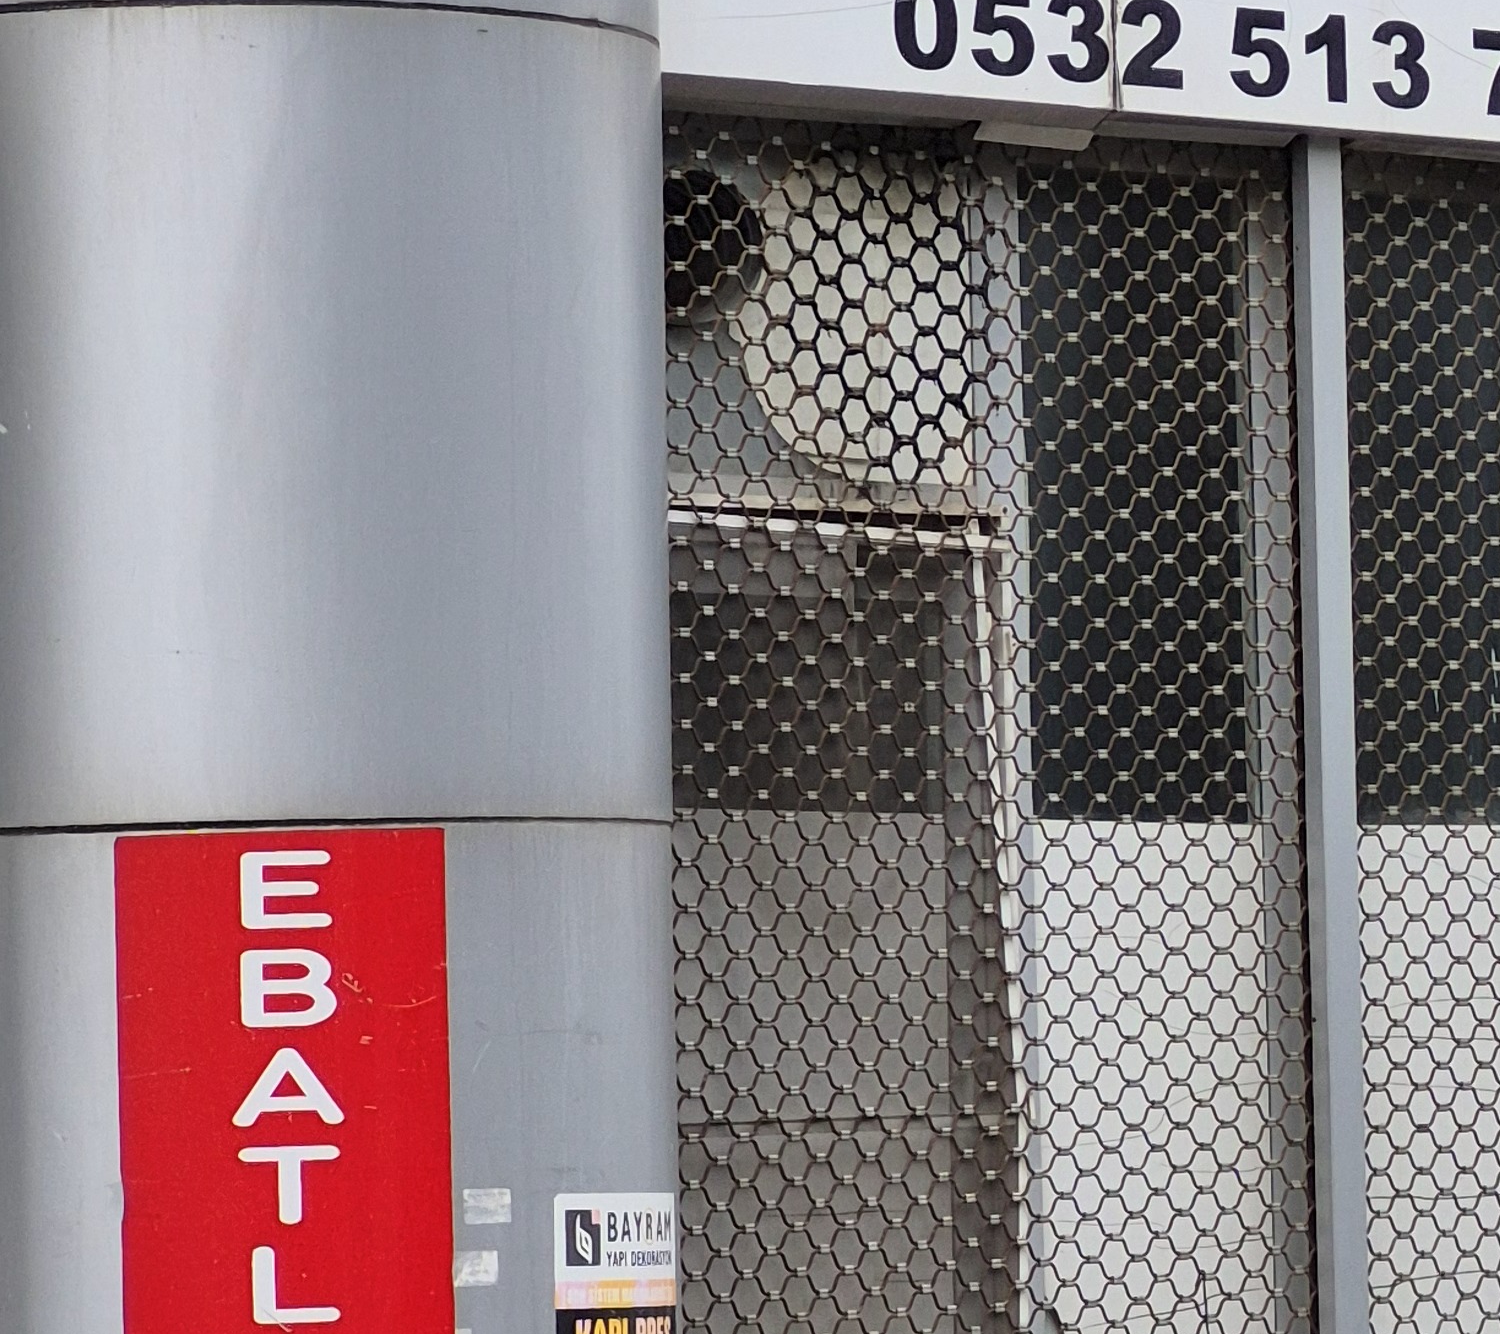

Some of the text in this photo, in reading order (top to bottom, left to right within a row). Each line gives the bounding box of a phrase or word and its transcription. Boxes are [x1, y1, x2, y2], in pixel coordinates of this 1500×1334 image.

[1229, 7, 1431, 110] 513
[607, 1210, 673, 1243] BAYRAM
[606, 1251, 629, 1267] YAPI
